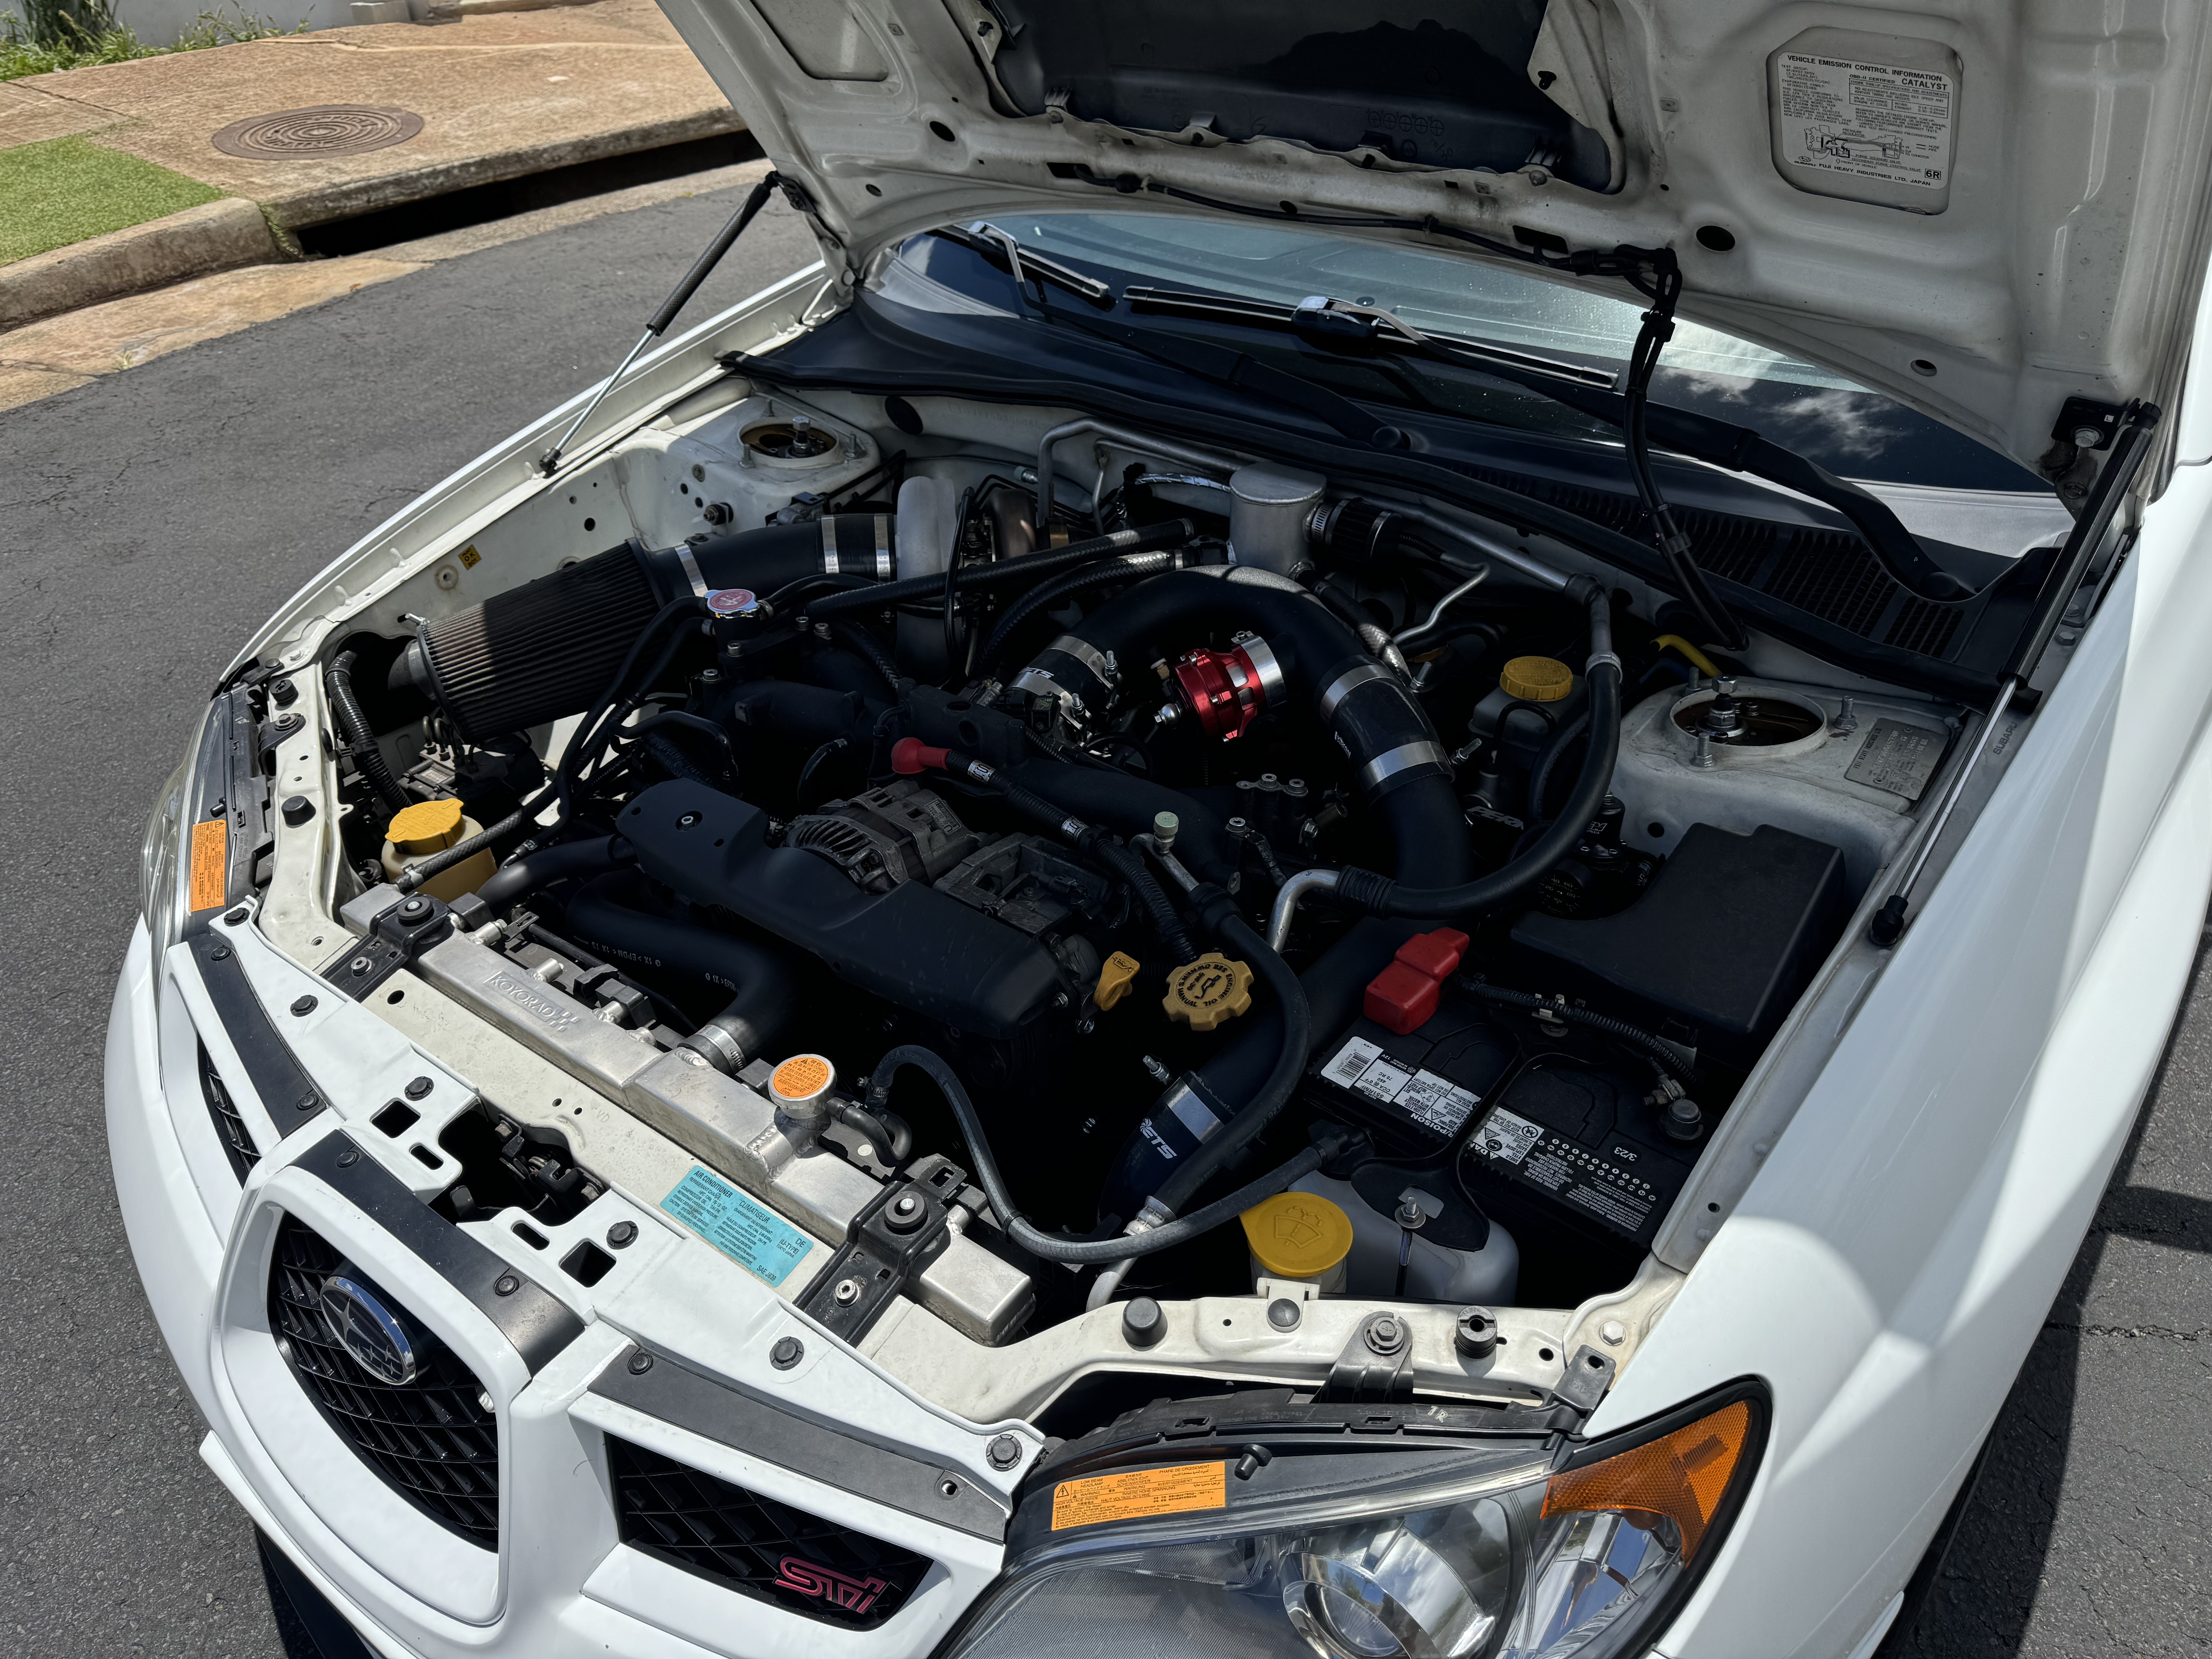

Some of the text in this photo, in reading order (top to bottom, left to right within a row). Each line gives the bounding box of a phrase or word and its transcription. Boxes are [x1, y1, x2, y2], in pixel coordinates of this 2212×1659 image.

[1788, 55, 1942, 81] VEHICLE EMISSION CONTROL INFORMATION
[1902, 78, 1947, 91] CATALYST
[1857, 170, 1891, 179] INDUSTRIES
[1927, 170, 1939, 179] 6R
[1993, 721, 2018, 755] SUBARU
[592, 942, 599, 950] TS
[1213, 964, 1228, 973] SEE
[490, 975, 556, 1017] KOYORAD
[1203, 973, 1234, 1006] ENGINE OIL
[1178, 988, 1197, 1007] MANUAL
[1359, 1084, 1384, 1099] 551RMF
[1379, 1084, 1391, 1092] CCA
[1407, 1085, 1421, 1094] MEDICAL
[1404, 1099, 1426, 1112] IMMEDIATELY
[1408, 1095, 1420, 1104] WATER.
[1438, 1119, 1455, 1130] SULFURIC
[1142, 1126, 1177, 1159] ETS
[1515, 1135, 1532, 1145] BLINDNESS
[1505, 1143, 1524, 1155] EXPLOSIVE
[1614, 1147, 1637, 1161] 3/23
[1505, 1154, 1518, 1163] SHIELD
[1525, 1157, 1548, 1170] RECOMMENDED
[1534, 1152, 1573, 1174] FOLLOW PROPER CHARGING
[1532, 1165, 1553, 1178] DISASSEMBLE
[1544, 1162, 1559, 1171] INVERTED
[693, 1170, 733, 1198] AIR CONDITIONER
[1542, 1176, 1559, 1186] EXPLOSION
[1543, 1181, 1558, 1190] WARNING:
[739, 1200, 770, 1223] CLIMATISEUR
[776, 1243, 786, 1252] TOKYO
[779, 1238, 799, 1254] (LI-TYPE)
[795, 1238, 806, 1248] DE
[756, 1265, 777, 1281] SAE J639
